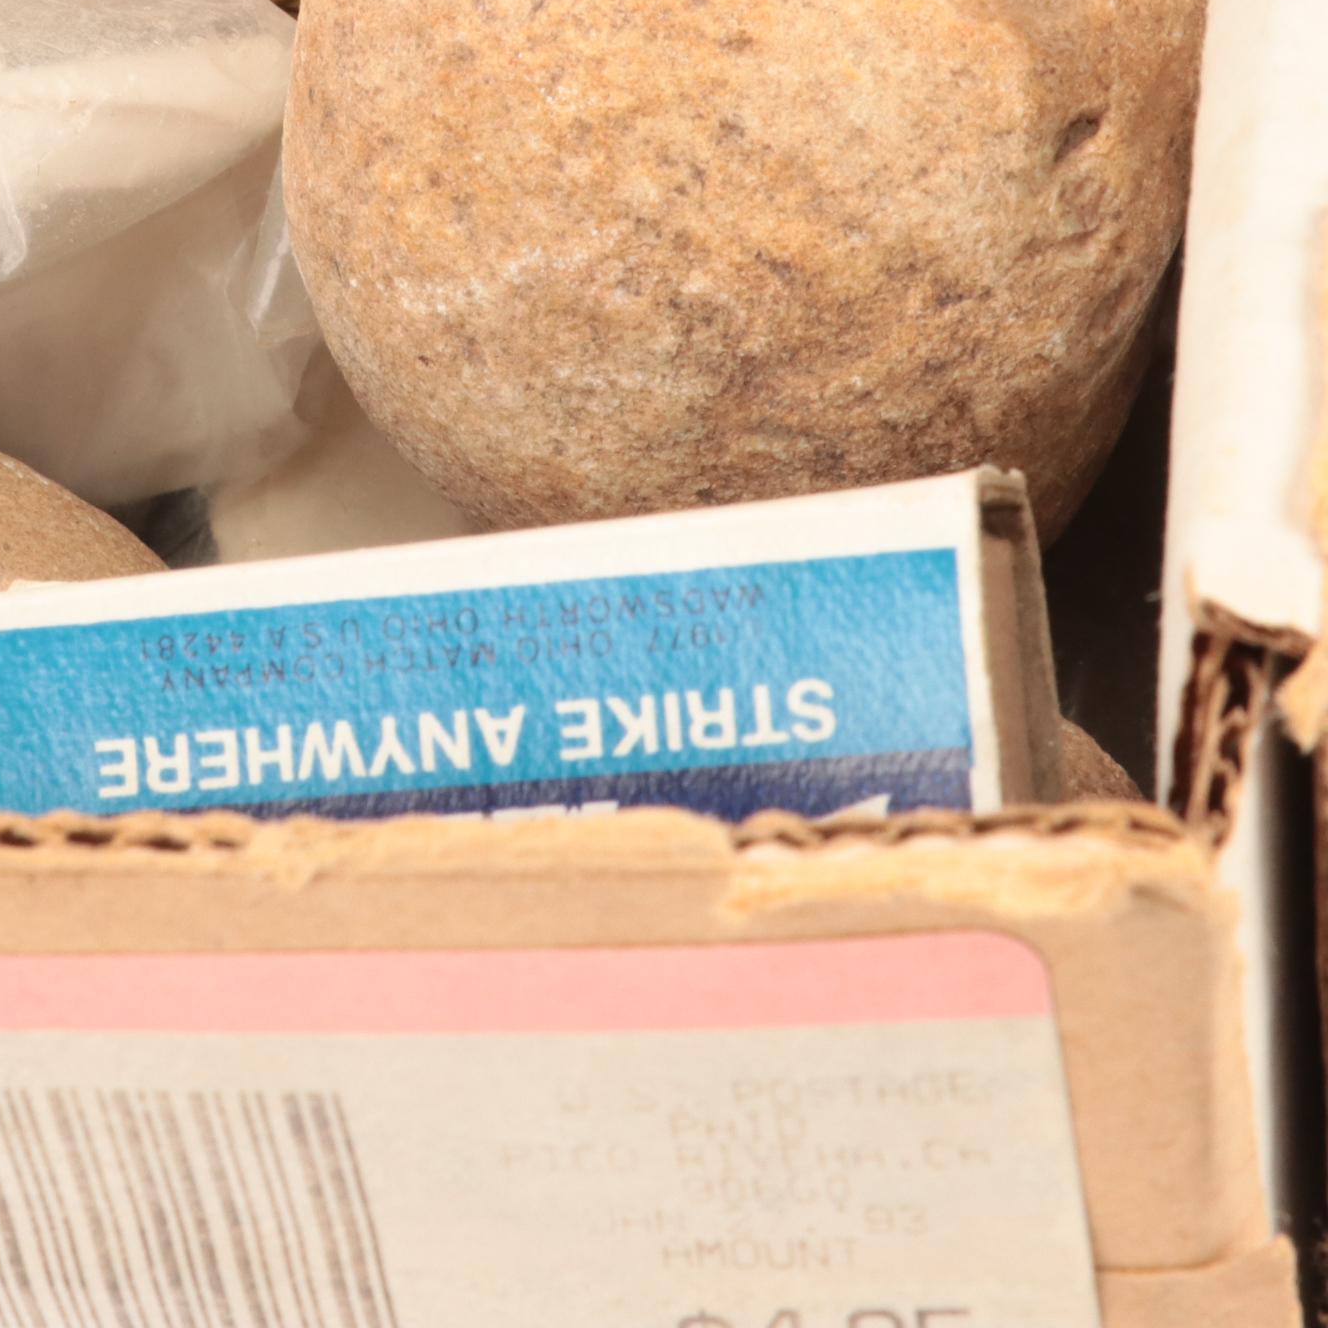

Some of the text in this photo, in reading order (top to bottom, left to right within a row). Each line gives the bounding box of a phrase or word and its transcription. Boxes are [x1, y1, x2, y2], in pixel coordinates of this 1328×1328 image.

[383, 607, 480, 642] OHIO
[503, 583, 769, 630] WADSWORTH
[365, 642, 497, 674] MATCH
[517, 629, 613, 665] OHIO
[161, 652, 345, 694] COMPANY
[97, 677, 837, 799] STRIKE ANYWHERE
